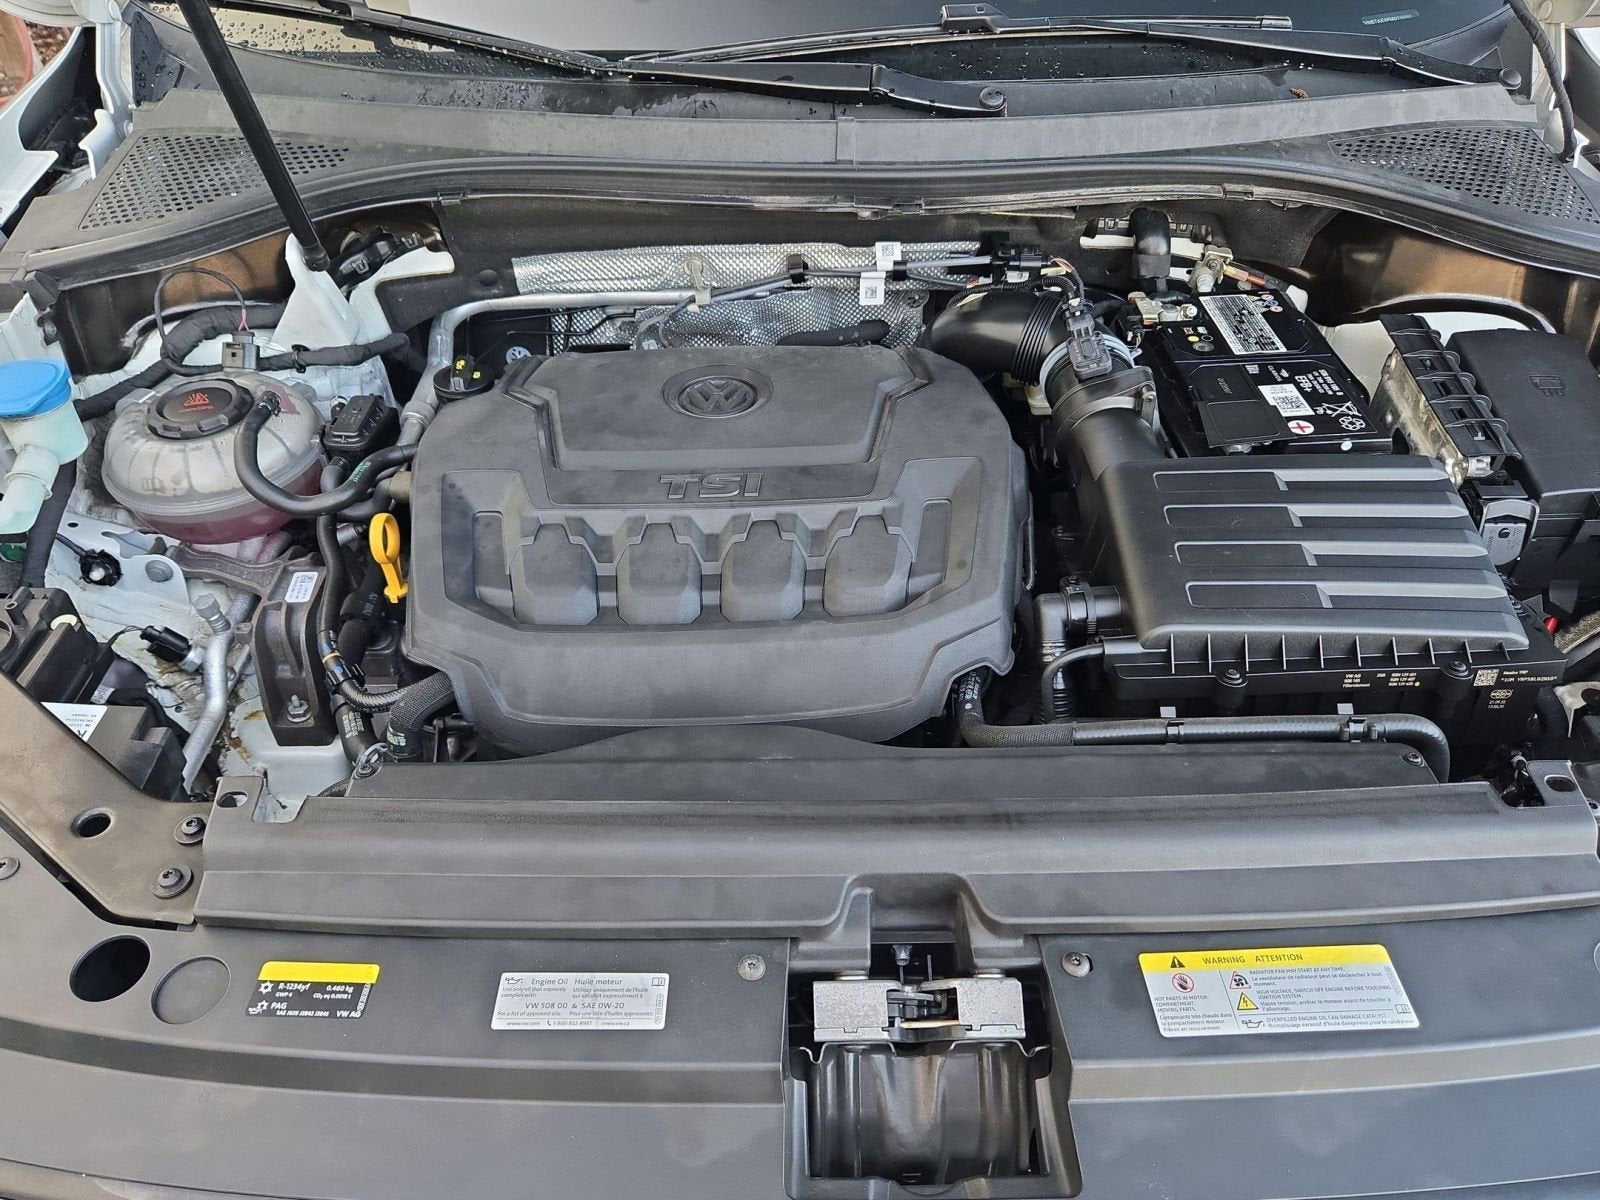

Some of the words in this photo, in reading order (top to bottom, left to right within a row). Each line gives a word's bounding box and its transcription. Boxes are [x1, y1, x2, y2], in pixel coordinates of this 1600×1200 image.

[659, 472, 764, 499] TSI
[1202, 956, 1246, 965] WARNING
[1255, 953, 1304, 962] ATTENTION
[277, 982, 310, 992] R-1234yf
